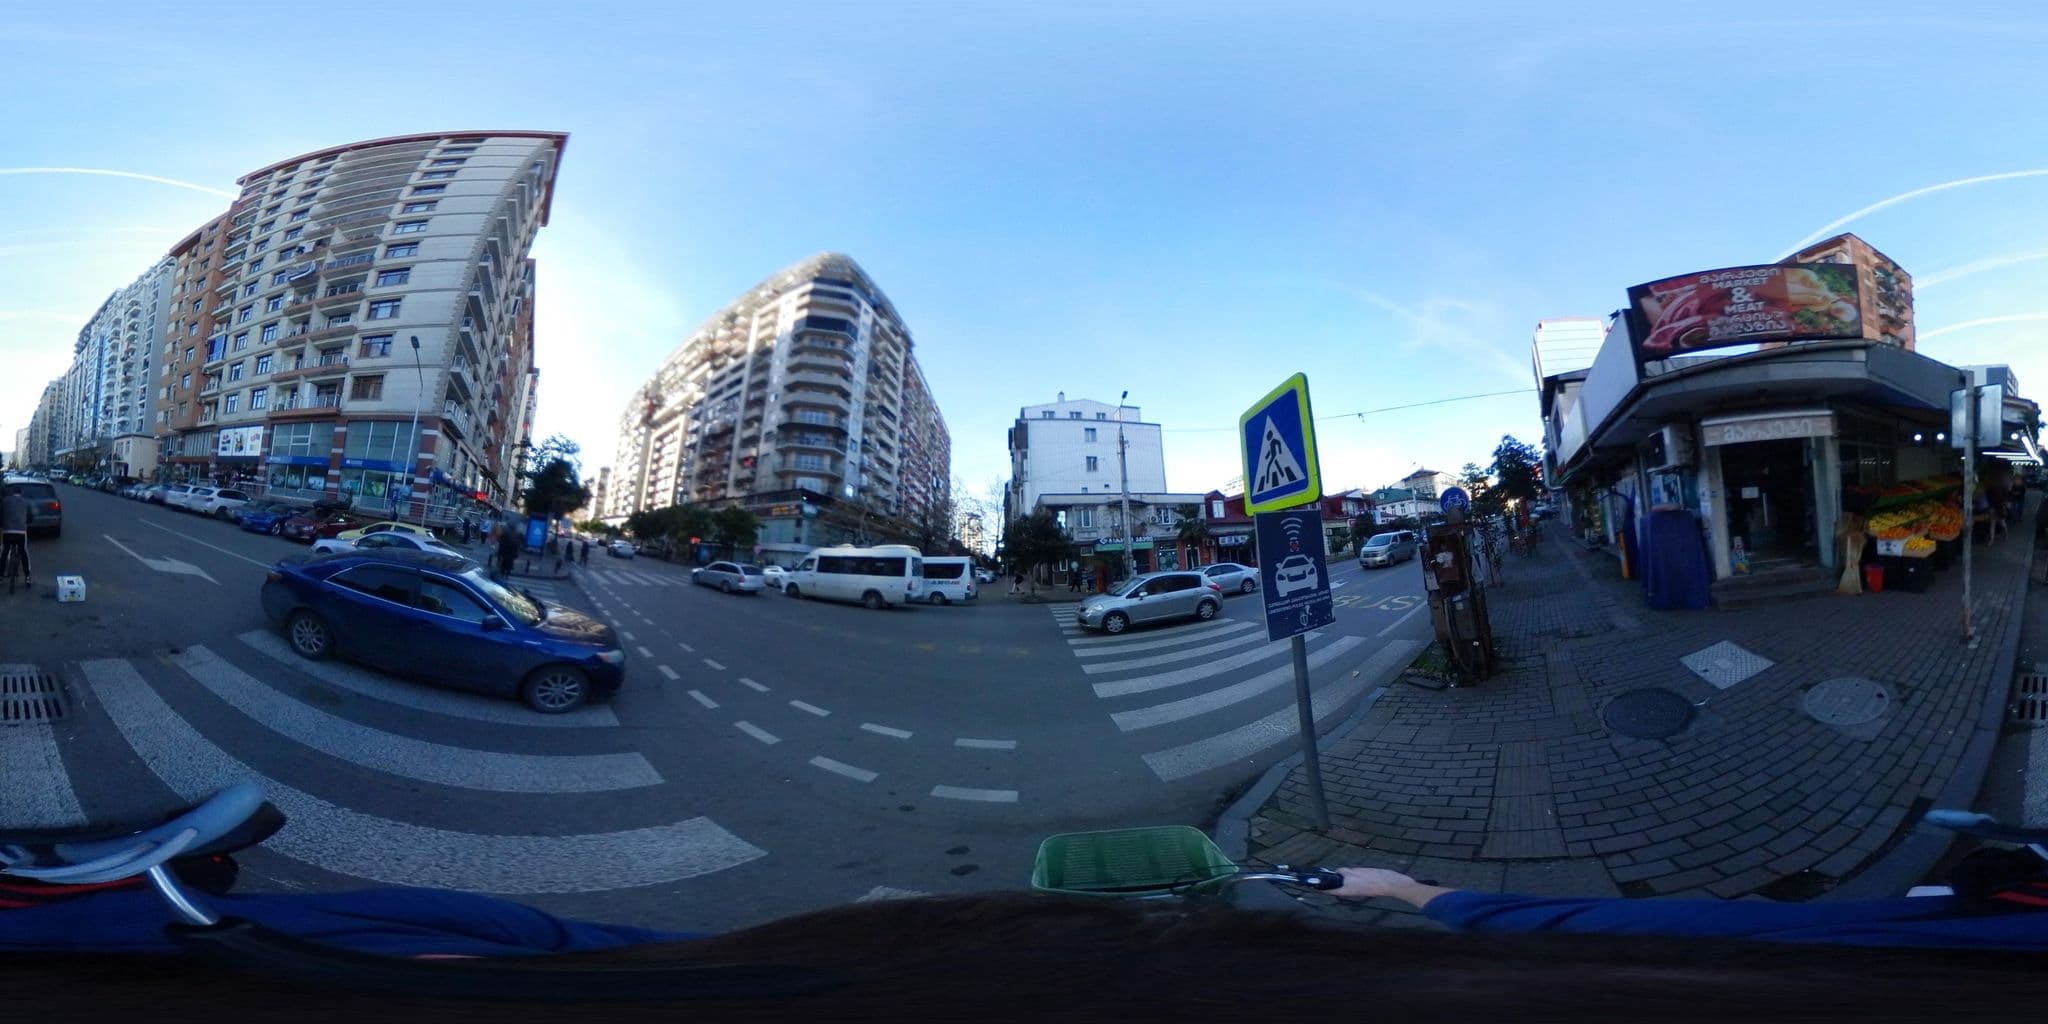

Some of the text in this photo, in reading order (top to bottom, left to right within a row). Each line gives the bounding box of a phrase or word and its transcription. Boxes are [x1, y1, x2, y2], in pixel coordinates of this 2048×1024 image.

[1699, 267, 1780, 284] მარკეტი
[1711, 277, 1769, 290] MARKET
[1731, 286, 1754, 303] &
[1724, 301, 1765, 315] MEAT
